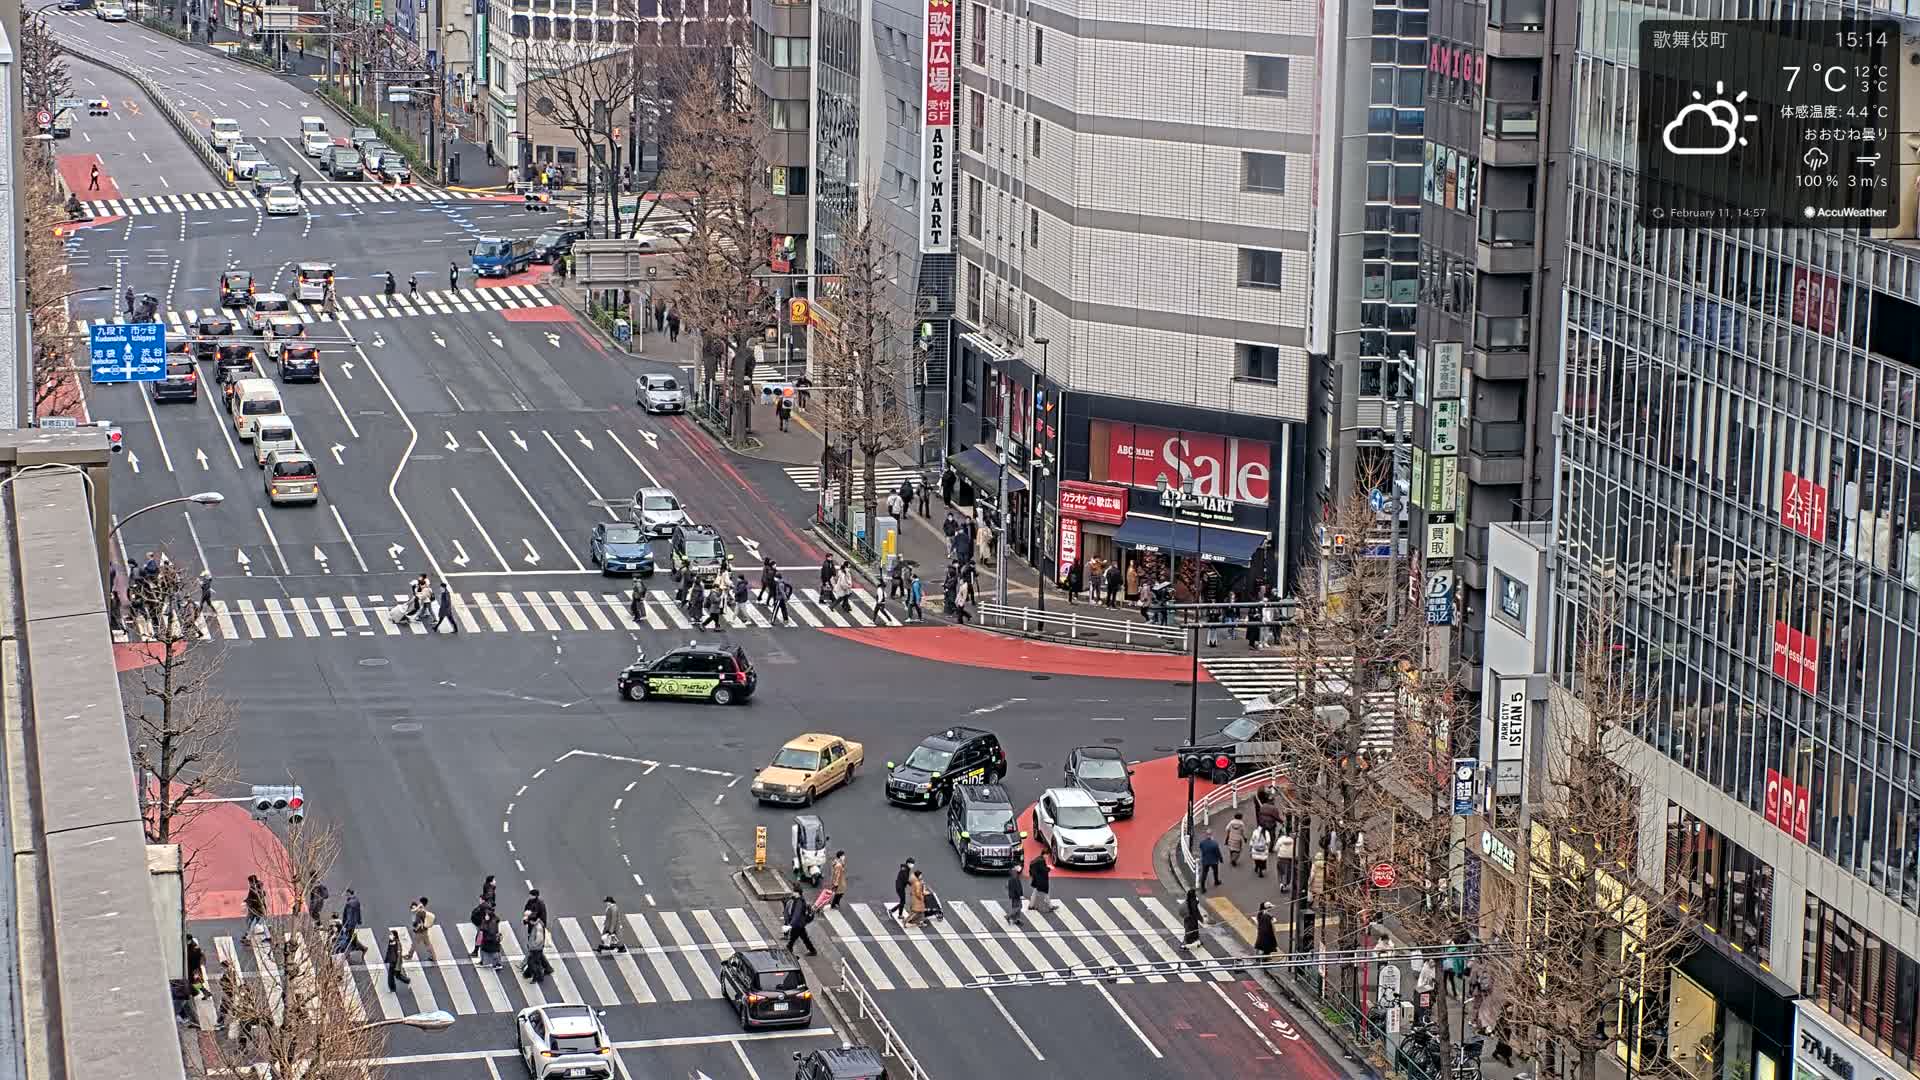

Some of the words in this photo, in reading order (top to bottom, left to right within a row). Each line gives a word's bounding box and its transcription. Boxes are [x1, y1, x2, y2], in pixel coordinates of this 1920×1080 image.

[929, 11, 951, 93] 歌広場
[1430, 43, 1483, 86] AMIGO
[928, 99, 950, 110] 受付
[928, 111, 950, 121] 5F
[931, 128, 943, 244] ABC-MART
[97, 326, 126, 335] 九段下
[1163, 437, 1270, 506] Sale
[1062, 492, 1088, 504] カラオケ
[1096, 496, 1121, 510] 歌広場
[1160, 489, 1234, 514] ABC-MART
[1787, 484, 1822, 532] 会計
[1436, 515, 1447, 523] 7F
[1432, 527, 1444, 554] 買取
[1511, 692, 1524, 702] 5
[1501, 703, 1509, 718] CITY
[1501, 722, 1509, 740] PARK
[1509, 706, 1523, 747] ISETAN
[1768, 781, 1806, 829] CPA
